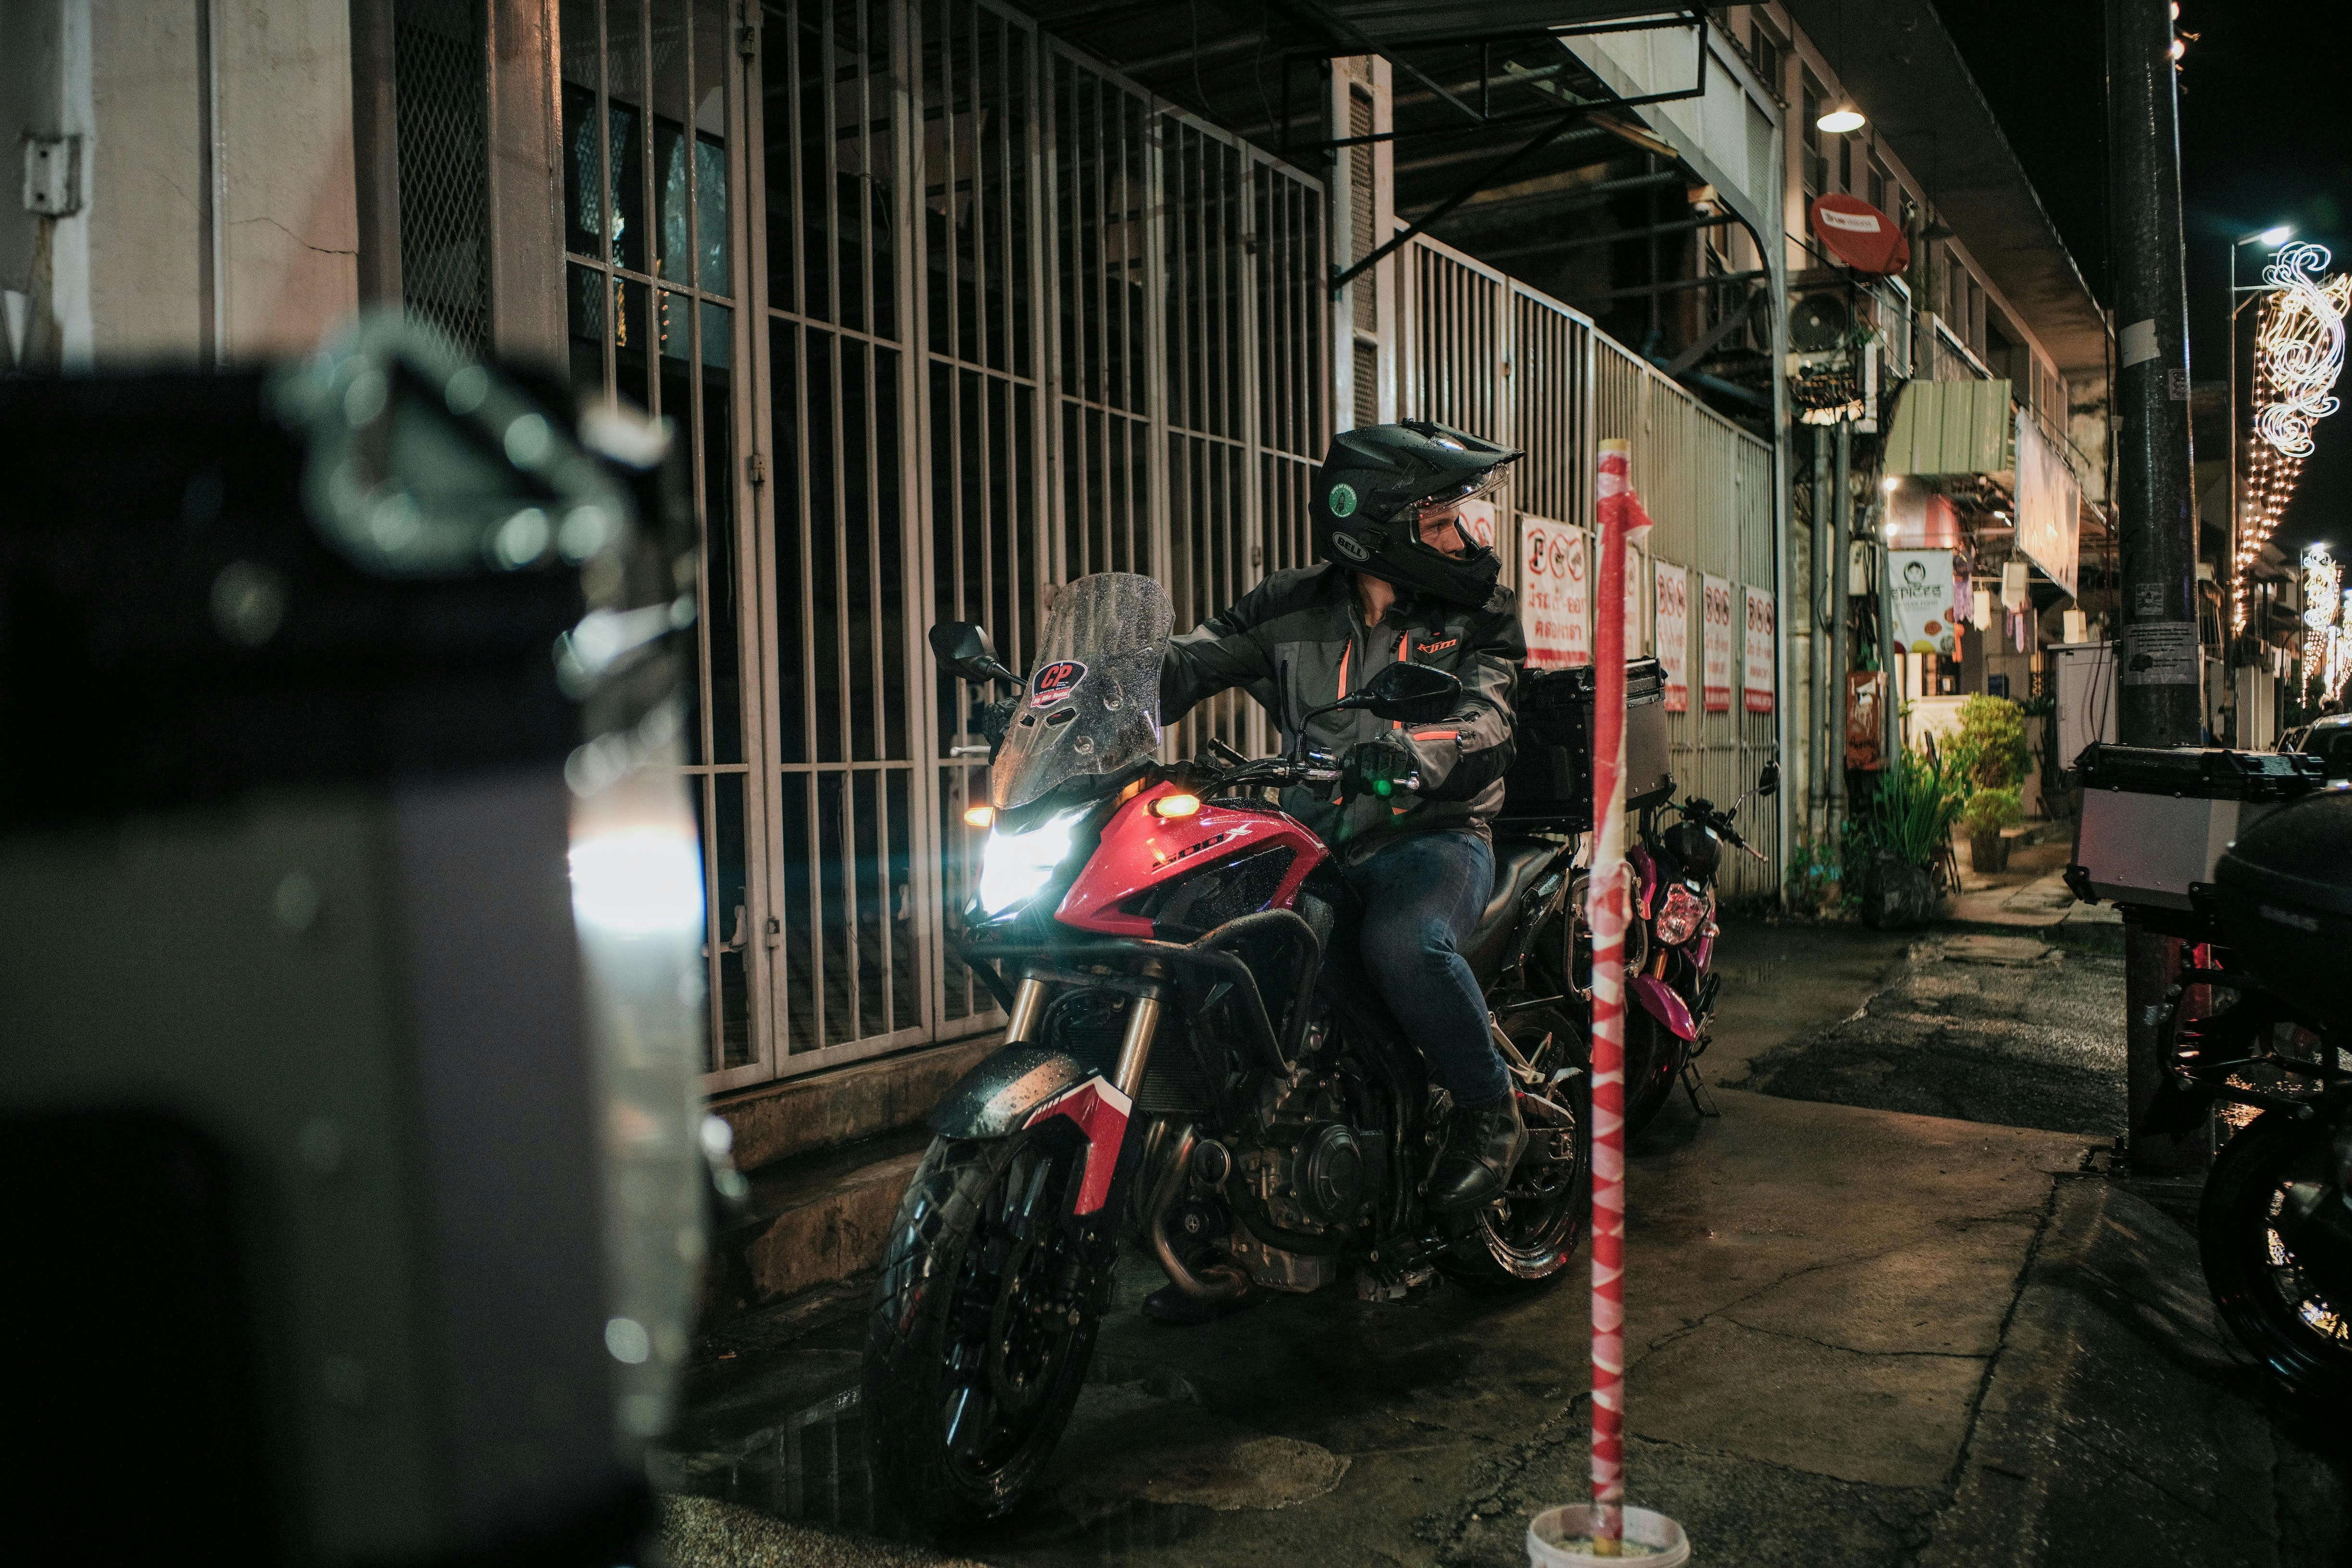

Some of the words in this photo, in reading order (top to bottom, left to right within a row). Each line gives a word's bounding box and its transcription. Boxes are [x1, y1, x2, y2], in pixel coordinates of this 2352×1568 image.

[1337, 536, 1362, 558] BELL
[1041, 665, 1073, 689] CP
[1053, 690, 1068, 698] Rental
